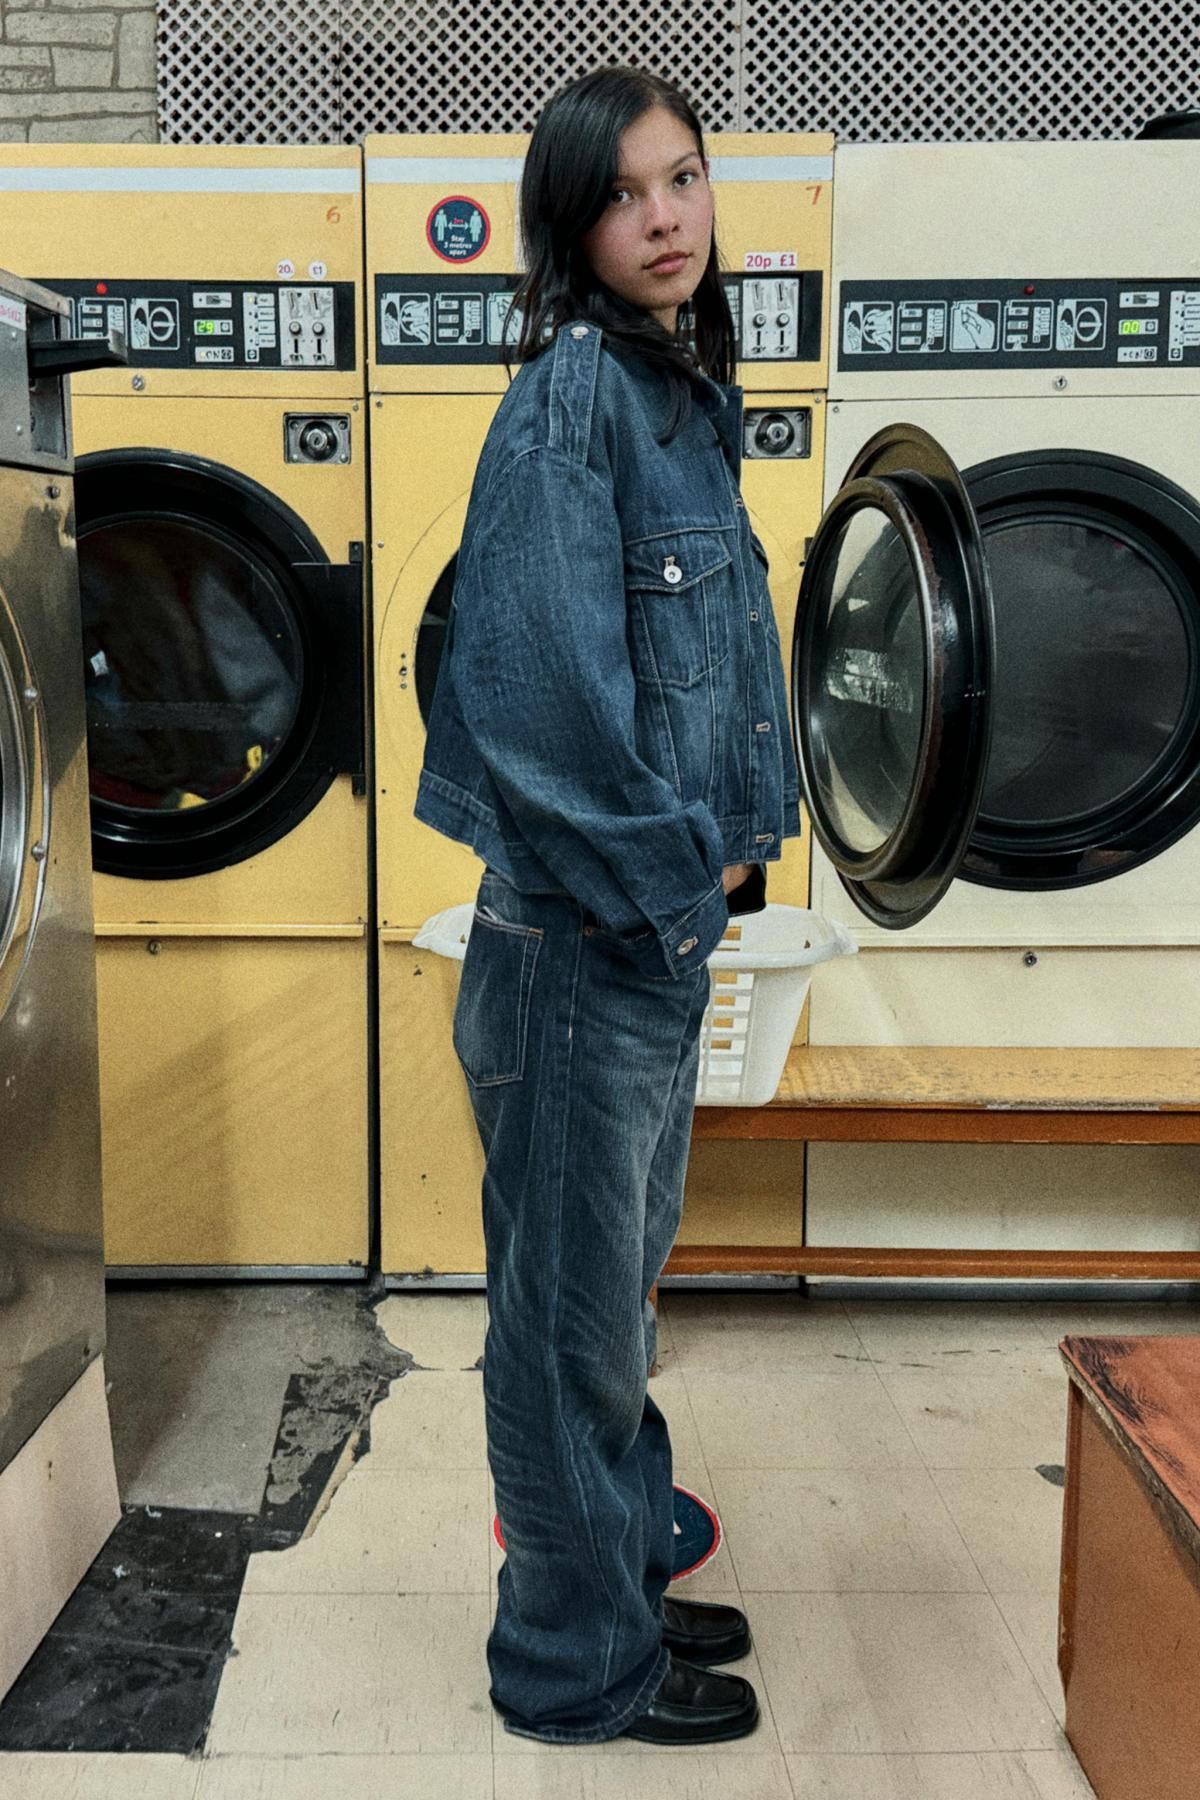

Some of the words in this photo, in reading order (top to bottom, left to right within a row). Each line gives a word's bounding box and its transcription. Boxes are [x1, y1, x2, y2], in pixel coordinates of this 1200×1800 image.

[805, 184, 822, 205] 7
[326, 205, 341, 224] 6
[451, 235, 465, 243] Stay
[449, 249, 467, 257] apart
[746, 254, 772, 270] 20p
[780, 253, 796, 267] £1
